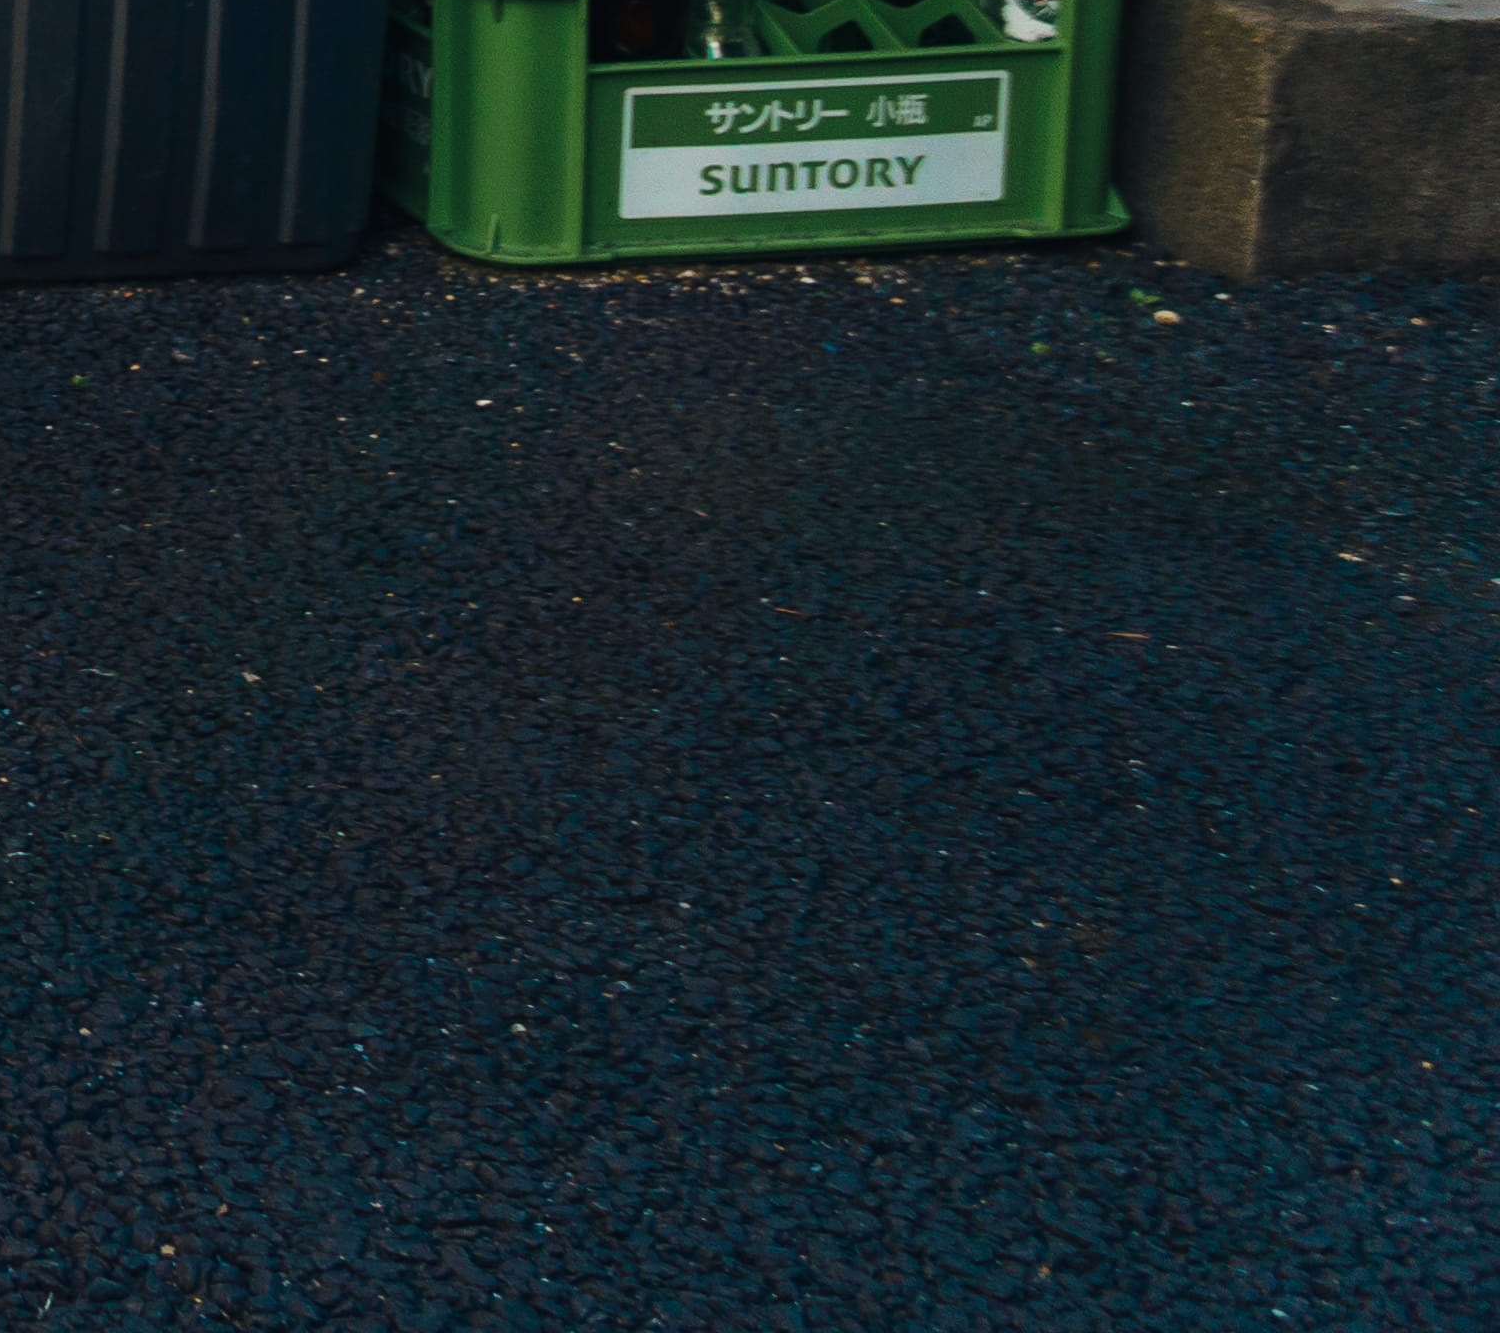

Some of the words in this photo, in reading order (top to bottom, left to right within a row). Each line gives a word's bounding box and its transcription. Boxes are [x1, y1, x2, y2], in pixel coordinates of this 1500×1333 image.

[703, 94, 850, 135] サントリー
[865, 93, 930, 128] 小瓶
[699, 154, 927, 196] SUNTORY
